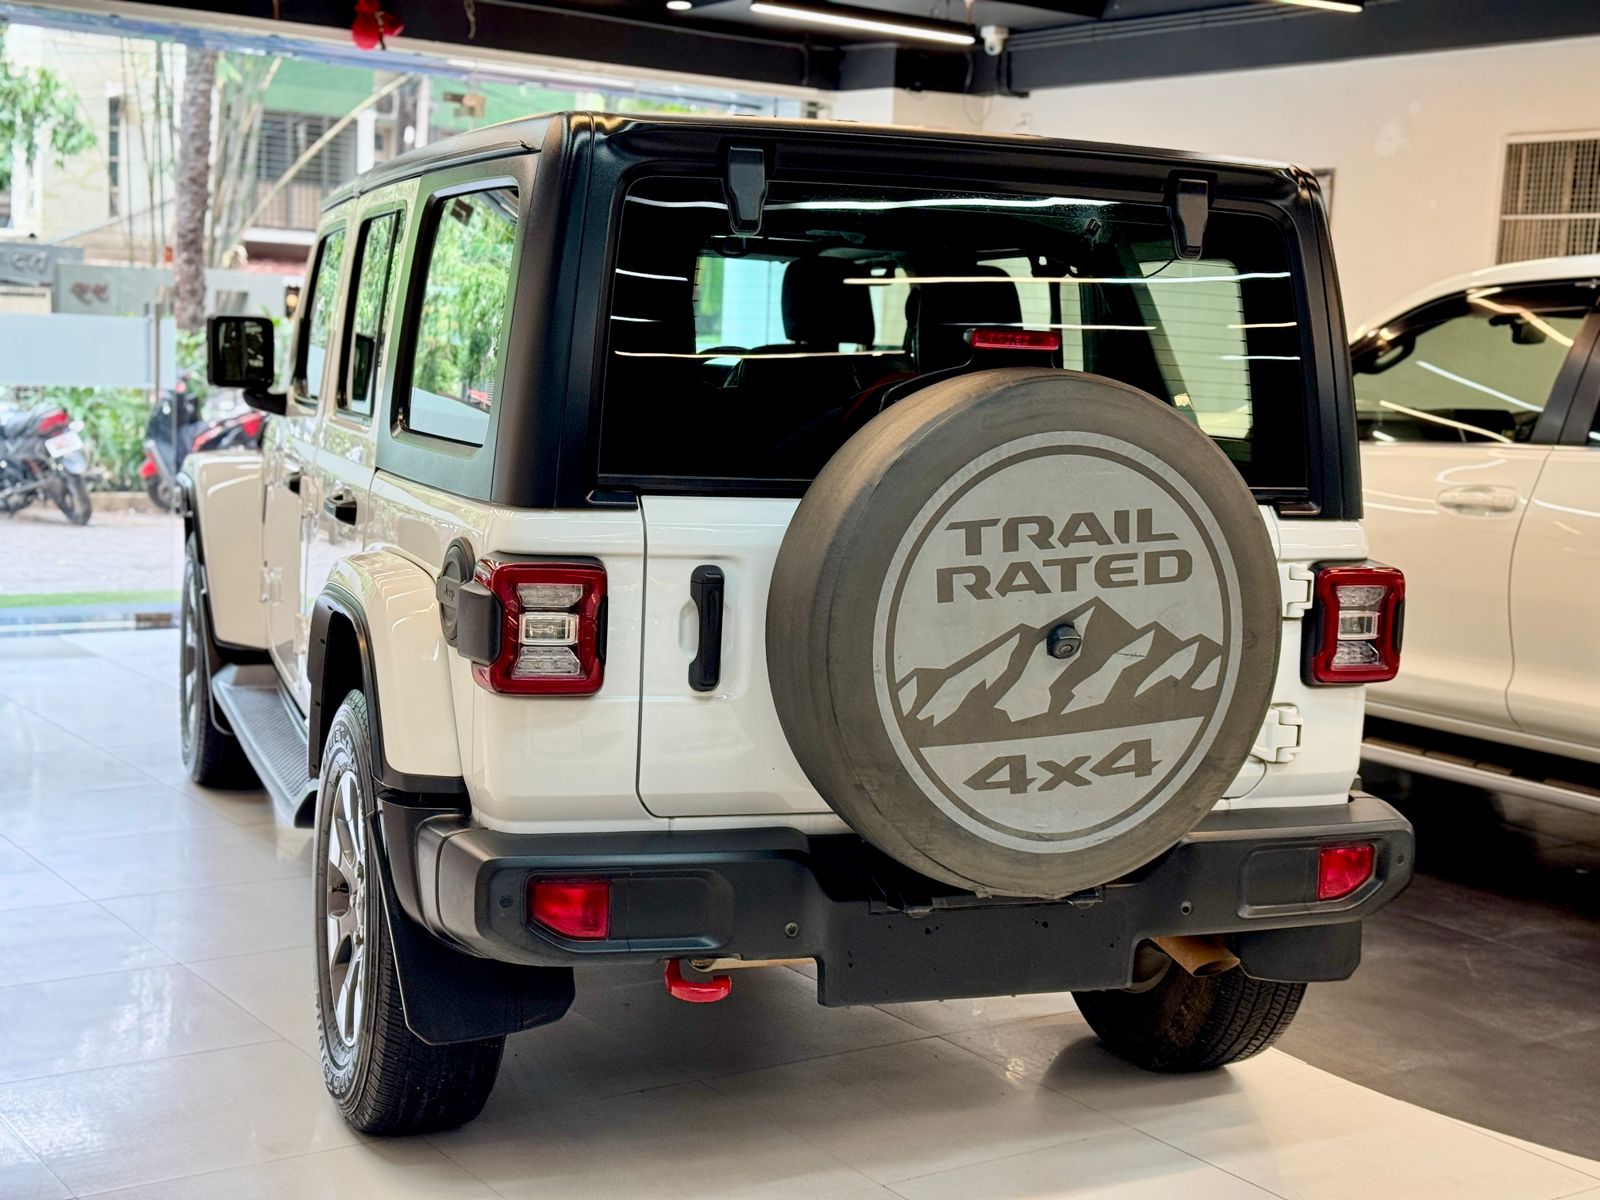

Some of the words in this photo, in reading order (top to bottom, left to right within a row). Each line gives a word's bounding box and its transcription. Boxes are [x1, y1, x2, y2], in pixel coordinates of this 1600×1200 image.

[944, 508, 1179, 556] TRAIL
[936, 549, 1193, 603] RATED
[963, 738, 1163, 794] 4x4
